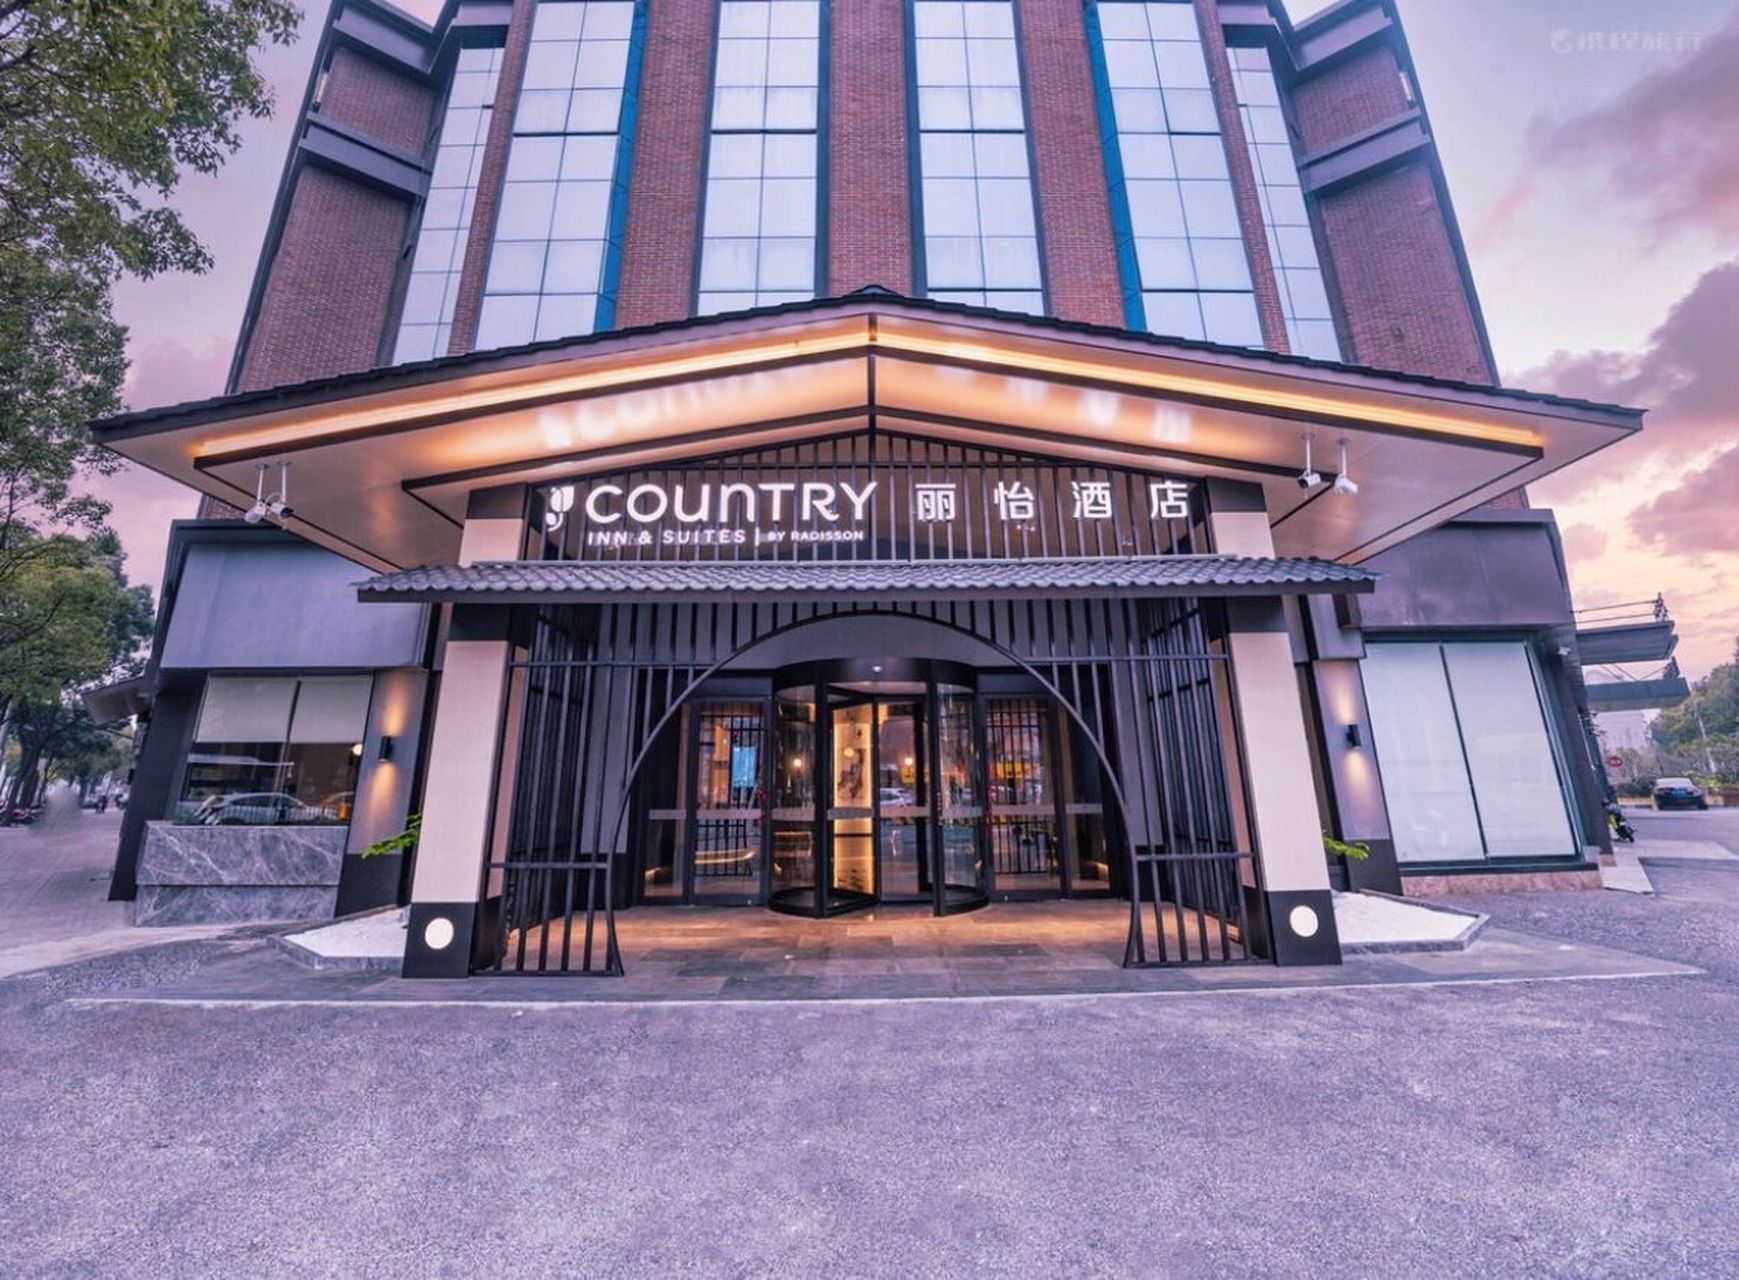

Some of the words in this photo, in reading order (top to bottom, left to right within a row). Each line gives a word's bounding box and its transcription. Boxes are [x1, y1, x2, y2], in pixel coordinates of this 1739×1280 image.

[915, 481, 1189, 521] 丽怡酒店
[588, 530, 628, 546] INN
[638, 530, 652, 544] &
[662, 529, 747, 545] SUITES
[768, 531, 785, 542] BY
[791, 530, 864, 542] RADISSON
